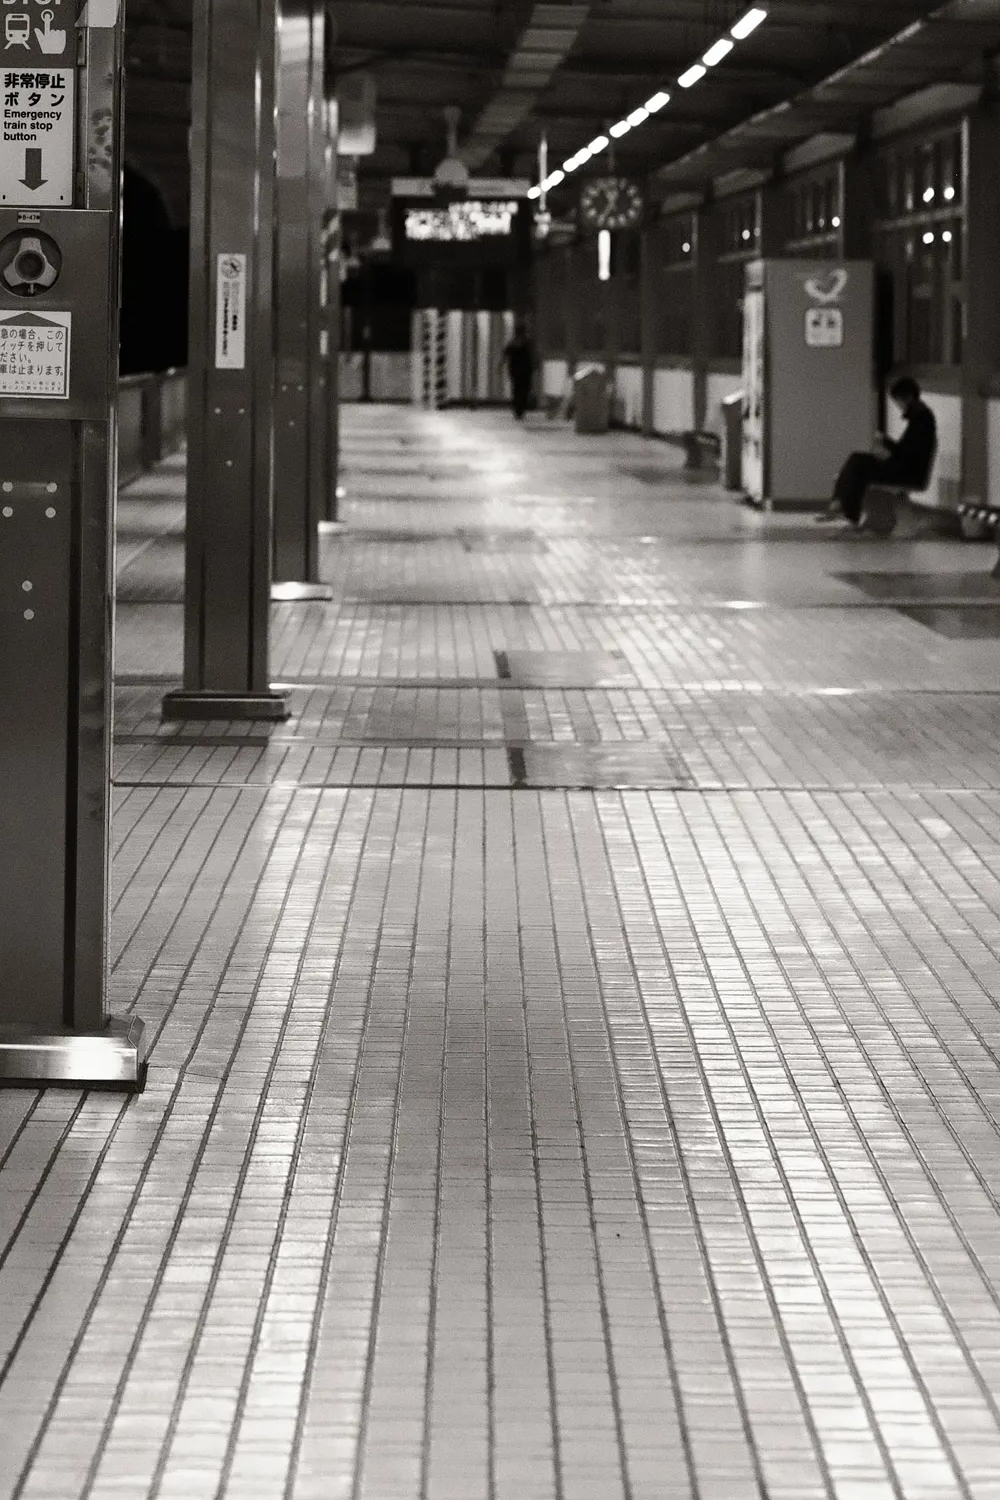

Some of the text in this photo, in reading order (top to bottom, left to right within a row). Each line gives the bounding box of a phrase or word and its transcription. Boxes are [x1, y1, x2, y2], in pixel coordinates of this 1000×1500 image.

[4, 72, 66, 89] 非常停止
[4, 91, 65, 107] ボタン
[3, 109, 62, 121] Emergency
[3, 121, 53, 132] train stop
[3, 132, 37, 141] button
